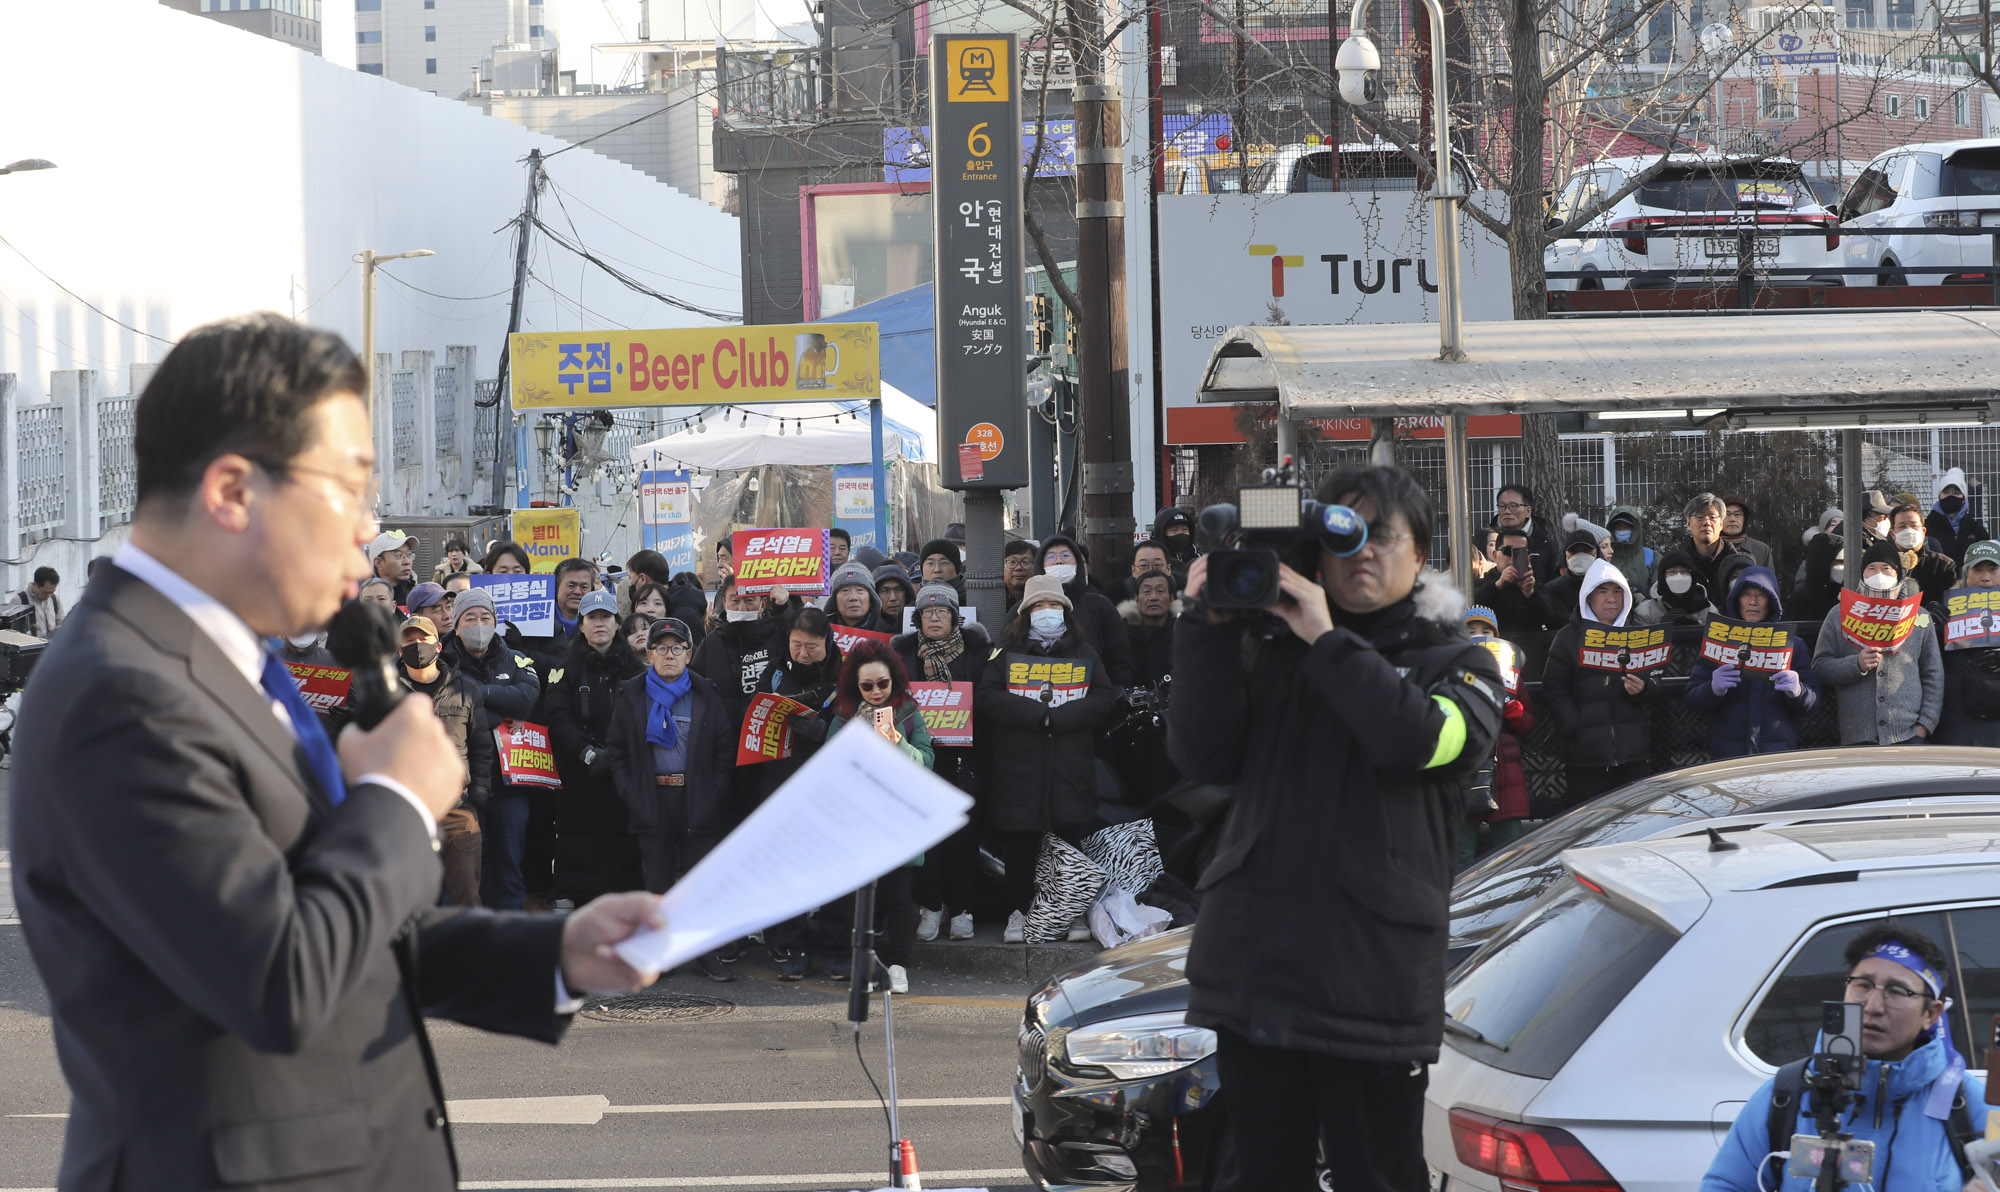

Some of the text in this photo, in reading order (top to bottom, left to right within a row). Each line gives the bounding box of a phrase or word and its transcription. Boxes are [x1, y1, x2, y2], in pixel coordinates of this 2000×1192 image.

[1052, 123, 1073, 135] 6번
[968, 122, 991, 157] 6
[966, 160, 994, 170] 출입구
[962, 173, 998, 181] Entrance
[959, 200, 985, 284] 안국
[986, 200, 1003, 284] (현대건설)
[1320, 254, 1438, 295] Turu
[962, 304, 1002, 318] Anguk
[958, 319, 986, 327] (Hyundai
[1190, 324, 1229, 340] 당신의
[971, 329, 994, 341] 安国
[962, 344, 1003, 355] アングク
[629, 342, 705, 391] Beer
[712, 336, 789, 390] Club
[977, 429, 993, 438] 328
[979, 441, 998, 452] 호선
[644, 486, 687, 497] 안국역 6번 출구
[838, 482, 869, 491] 안국역 6번
[668, 511, 682, 519] club
[844, 506, 860, 514] beer
[532, 524, 560, 540] 별미
[523, 541, 570, 557] Manu
[745, 535, 813, 556] 윤석열을
[736, 556, 821, 579] 파면하라!
[1708, 621, 1788, 647] 윤석열을
[1842, 615, 1915, 642] 파면하라!
[1585, 628, 1664, 649] 윤석열을
[1583, 646, 1670, 670] 파면하라!
[1704, 641, 1790, 670] 파면하라!
[313, 668, 350, 682] 윤석열
[1009, 662, 1086, 684] 윤석열을
[905, 688, 962, 707] 석열을
[745, 698, 775, 752] 윤석열을
[762, 698, 800, 759] 파면하라!
[920, 709, 971, 729] 하라!
[510, 728, 546, 749] 윤석열을
[509, 748, 554, 772] 파면하라!
